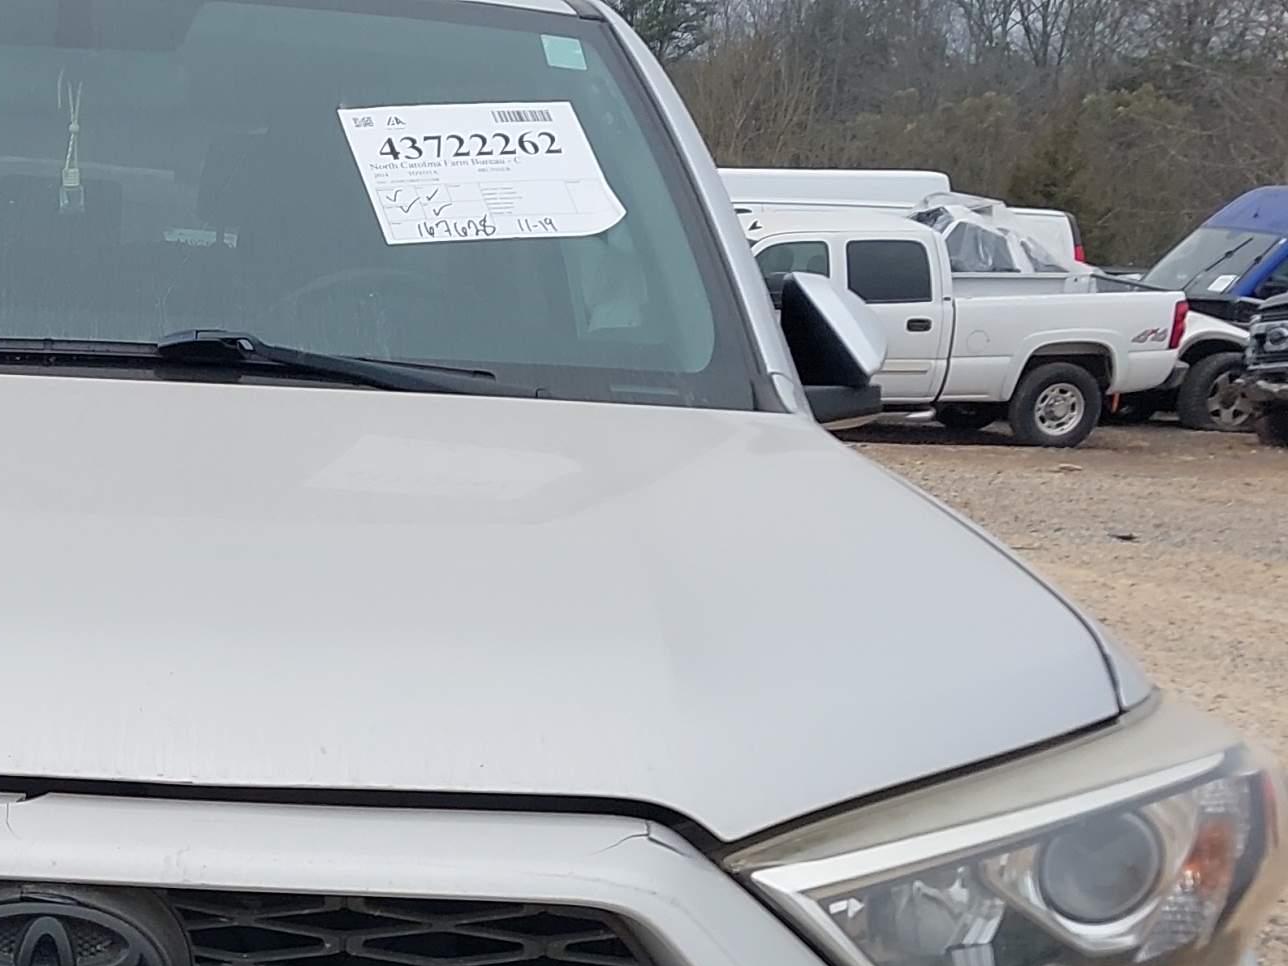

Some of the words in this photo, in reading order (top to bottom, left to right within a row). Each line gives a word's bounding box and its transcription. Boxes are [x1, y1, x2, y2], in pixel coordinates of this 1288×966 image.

[379, 131, 562, 160] 43722262
[369, 161, 399, 171] North
[401, 160, 442, 169] Carolina
[444, 159, 470, 168] Farm
[471, 158, 505, 166] Bureau
